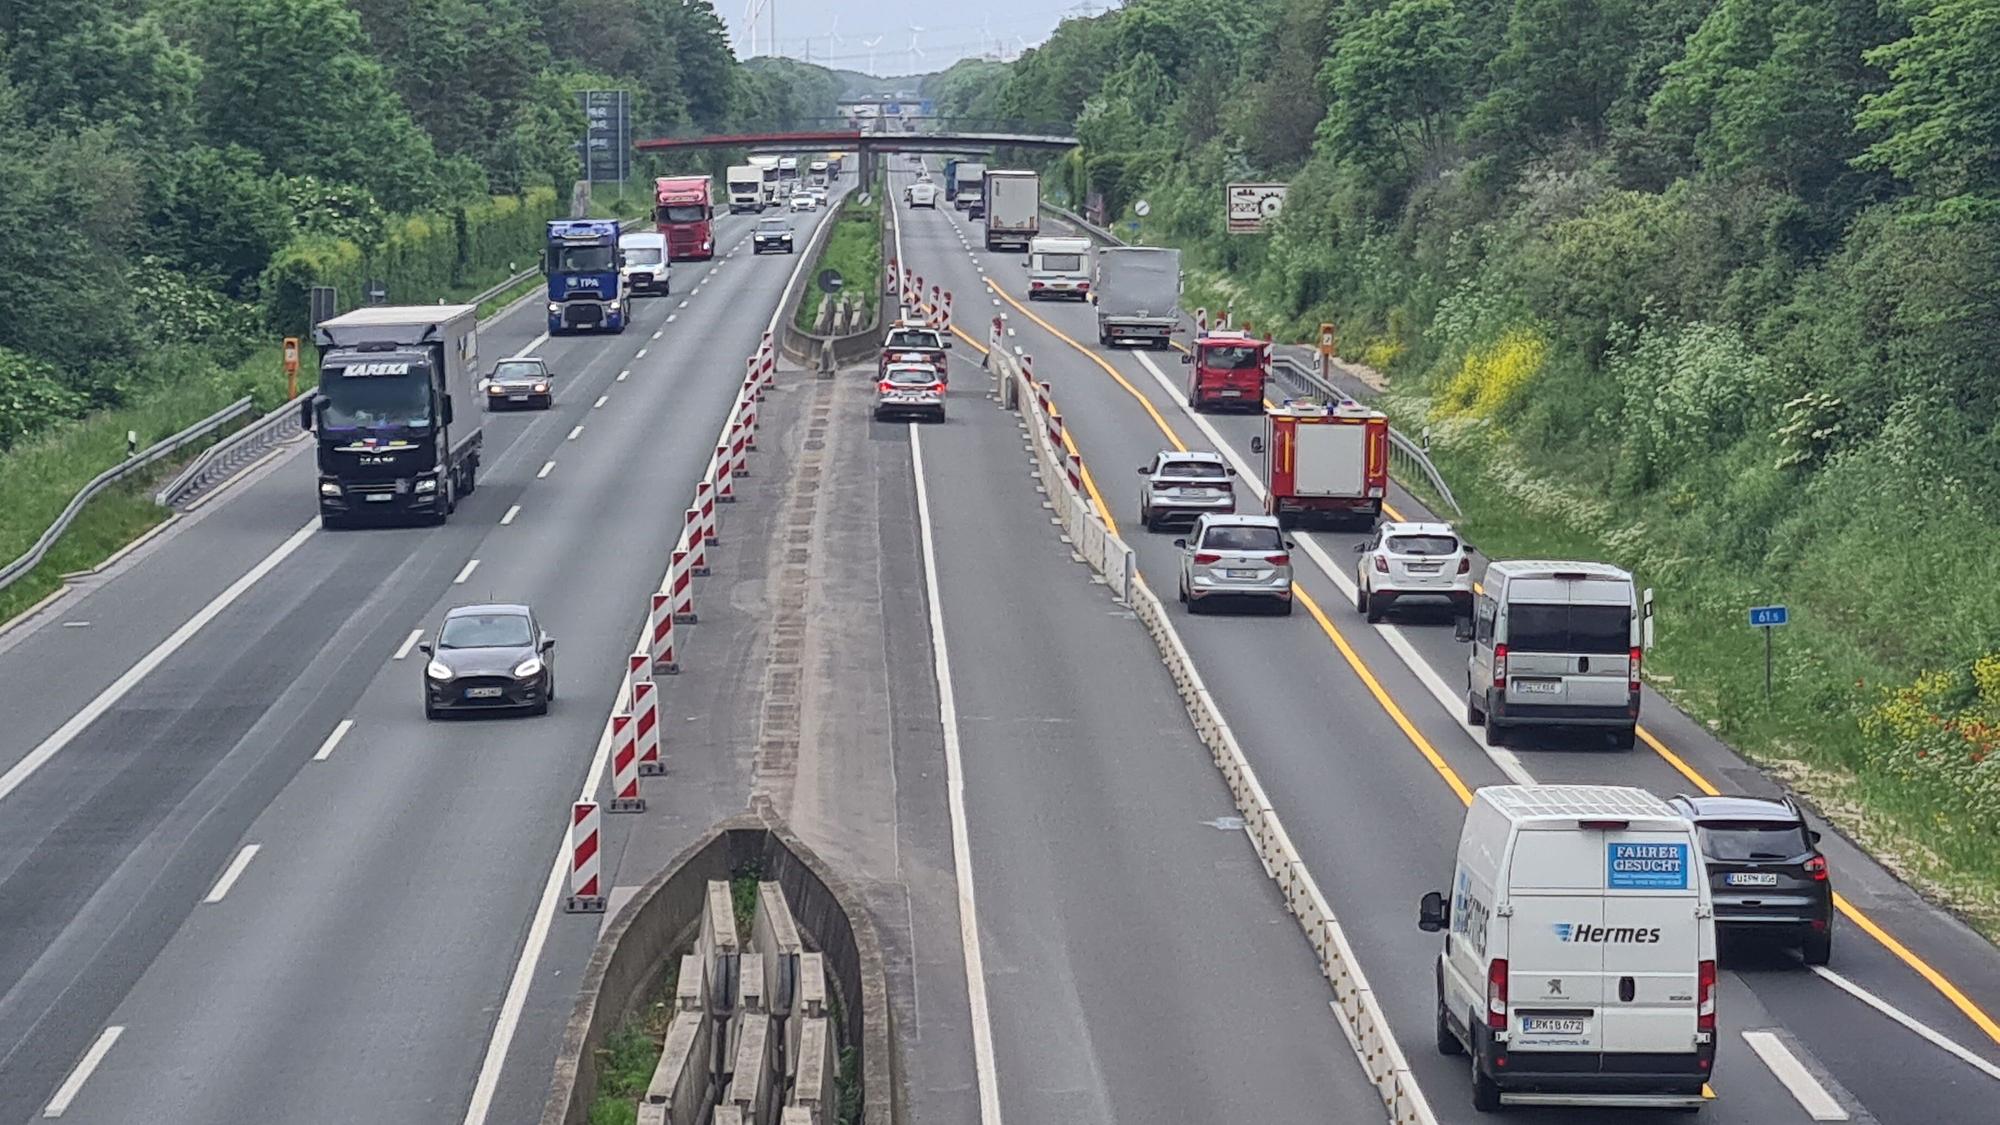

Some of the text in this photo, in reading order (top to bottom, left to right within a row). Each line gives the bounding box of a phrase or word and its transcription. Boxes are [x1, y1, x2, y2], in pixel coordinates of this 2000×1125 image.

[580, 277, 600, 287] TPA
[1617, 846, 1679, 858] FAHRER
[1613, 860, 1681, 871] GESUCHT
[1574, 924, 1662, 944] Hermes
